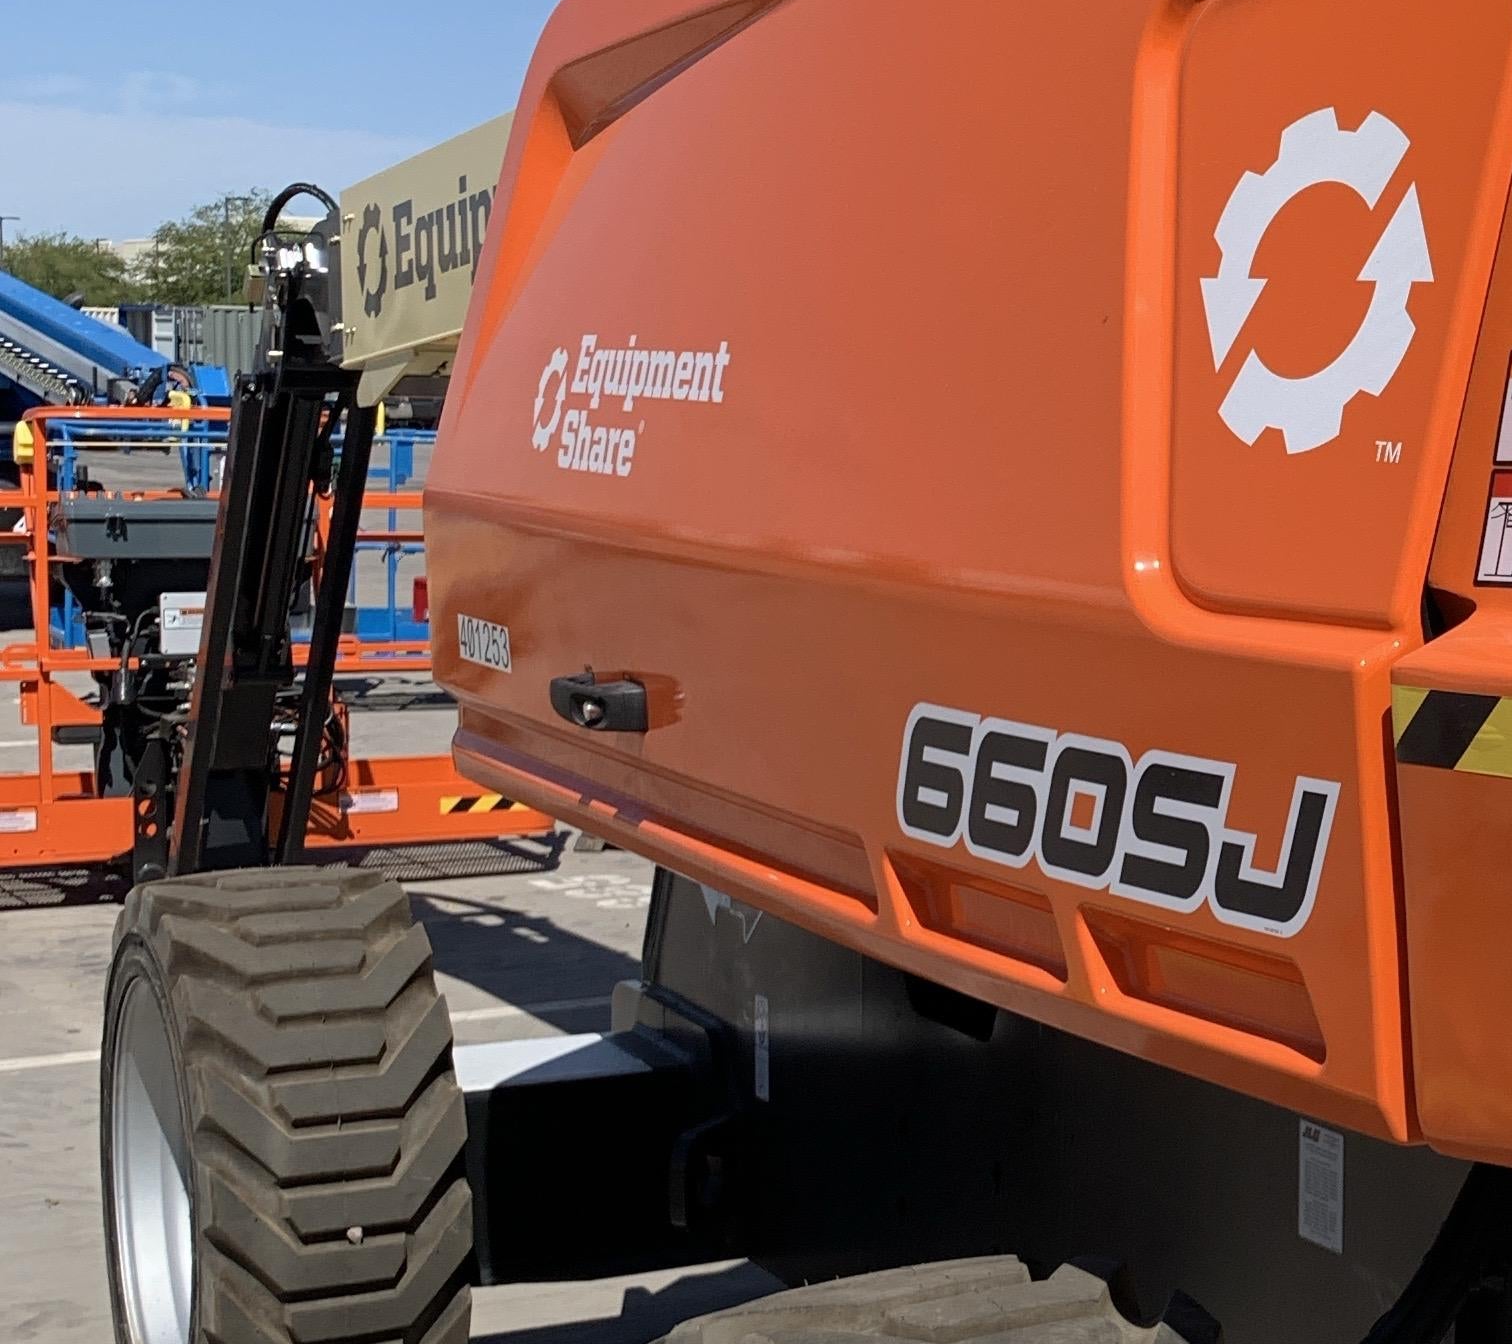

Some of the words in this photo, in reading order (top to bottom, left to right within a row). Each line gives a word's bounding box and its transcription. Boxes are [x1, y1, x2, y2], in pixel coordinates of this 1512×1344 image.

[571, 334, 731, 412] Equipment
[558, 408, 636, 477] Share
[460, 615, 510, 669] 401253
[897, 702, 1341, 938] 660SJ
